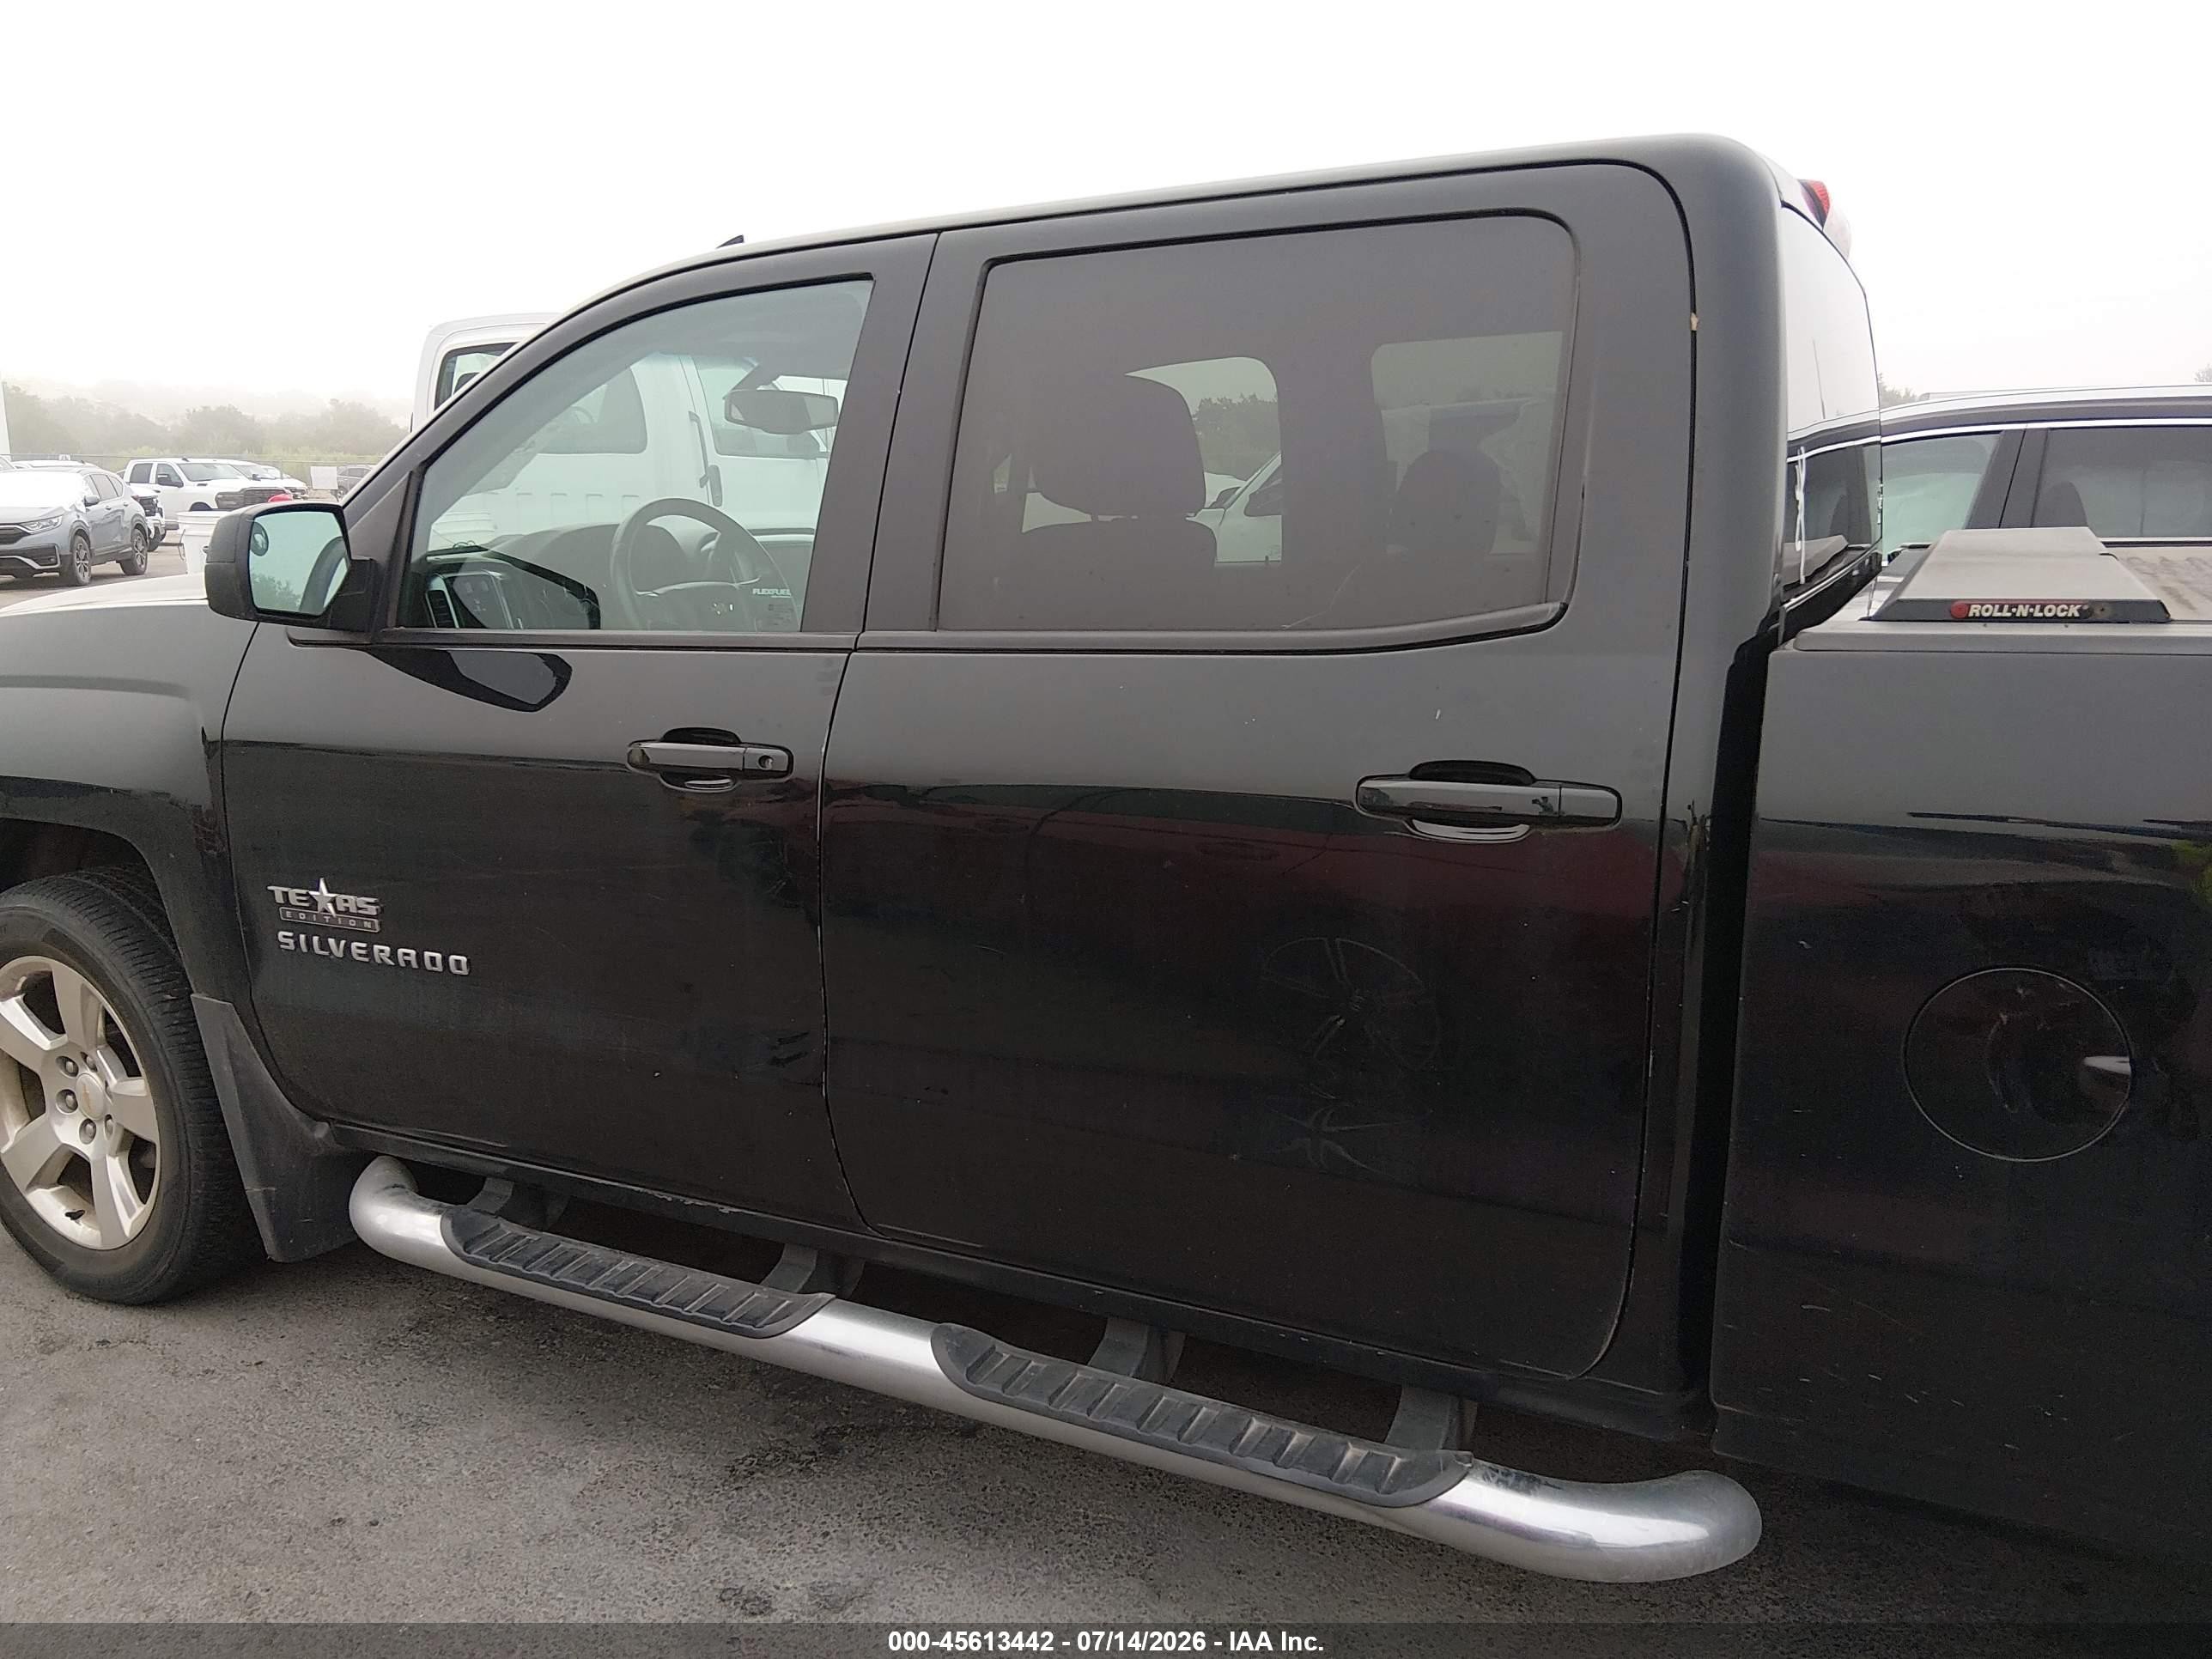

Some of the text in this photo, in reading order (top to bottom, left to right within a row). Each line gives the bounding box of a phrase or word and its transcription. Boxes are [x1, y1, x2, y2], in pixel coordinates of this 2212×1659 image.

[266, 877, 381, 917] TEXAS
[285, 910, 373, 929] EDITION
[277, 930, 471, 975] SILVERADO
